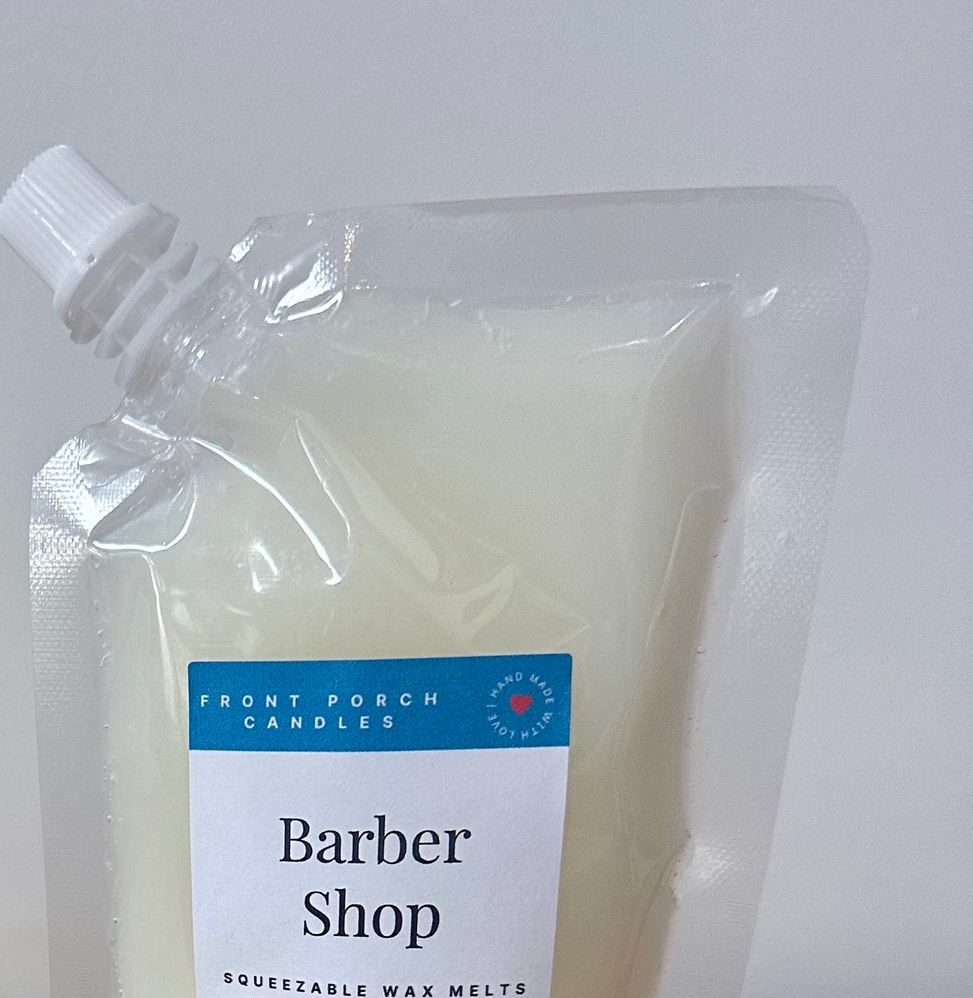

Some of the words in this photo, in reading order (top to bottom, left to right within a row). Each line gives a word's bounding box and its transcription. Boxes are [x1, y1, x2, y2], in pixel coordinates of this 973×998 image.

[490, 671, 523, 698] HAND
[529, 673, 555, 704] MADE
[200, 694, 300, 709] FRONT
[328, 692, 438, 708] PORCH
[244, 715, 394, 730] CANDLES
[488, 713, 515, 739] LOVE
[521, 712, 554, 740] WITH
[279, 815, 472, 865] Barber
[303, 888, 441, 949] Shop
[223, 972, 367, 998] SQUEEZABLE
[382, 984, 434, 998] WAX
[449, 982, 527, 998] MELTS
